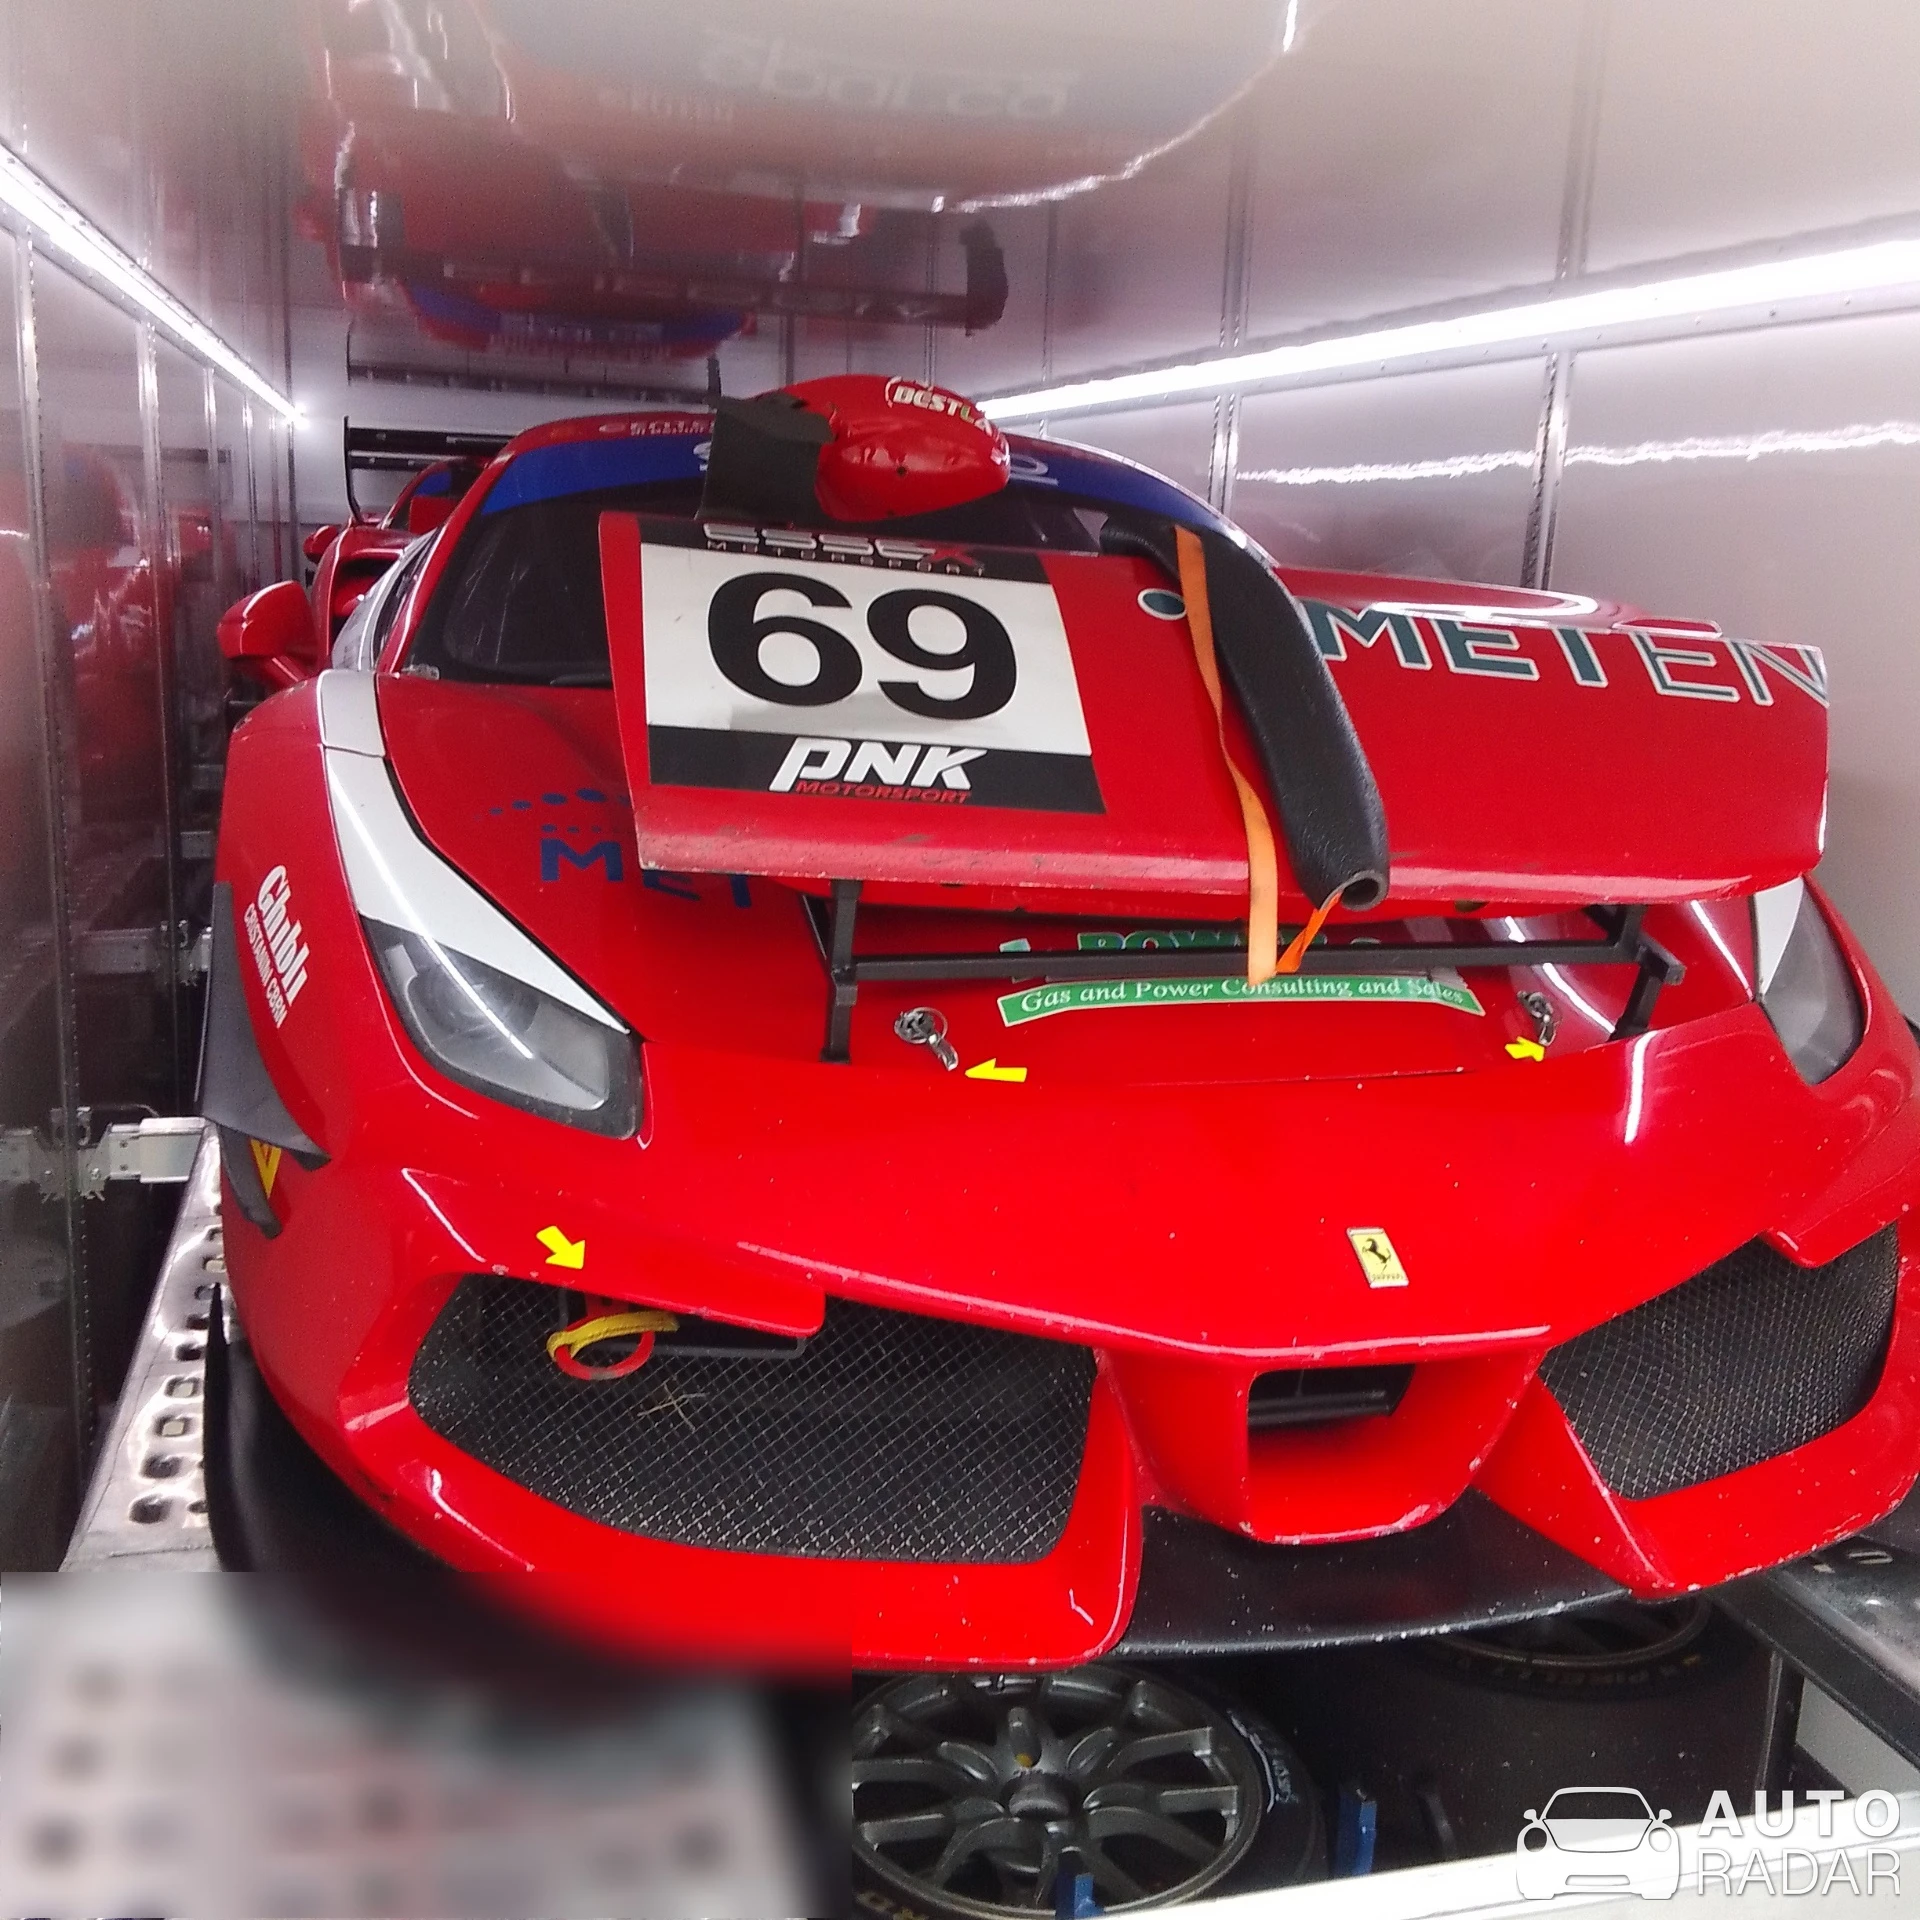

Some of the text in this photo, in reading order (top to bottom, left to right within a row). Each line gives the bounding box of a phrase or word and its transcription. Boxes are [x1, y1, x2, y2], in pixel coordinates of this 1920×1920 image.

[708, 572, 1017, 721] 69
[1302, 600, 1829, 708] METEN
[769, 736, 988, 793] PNK
[795, 780, 971, 804] MOTORSPORT
[1021, 977, 1463, 1012] Gas and Power Consulting and Sales
